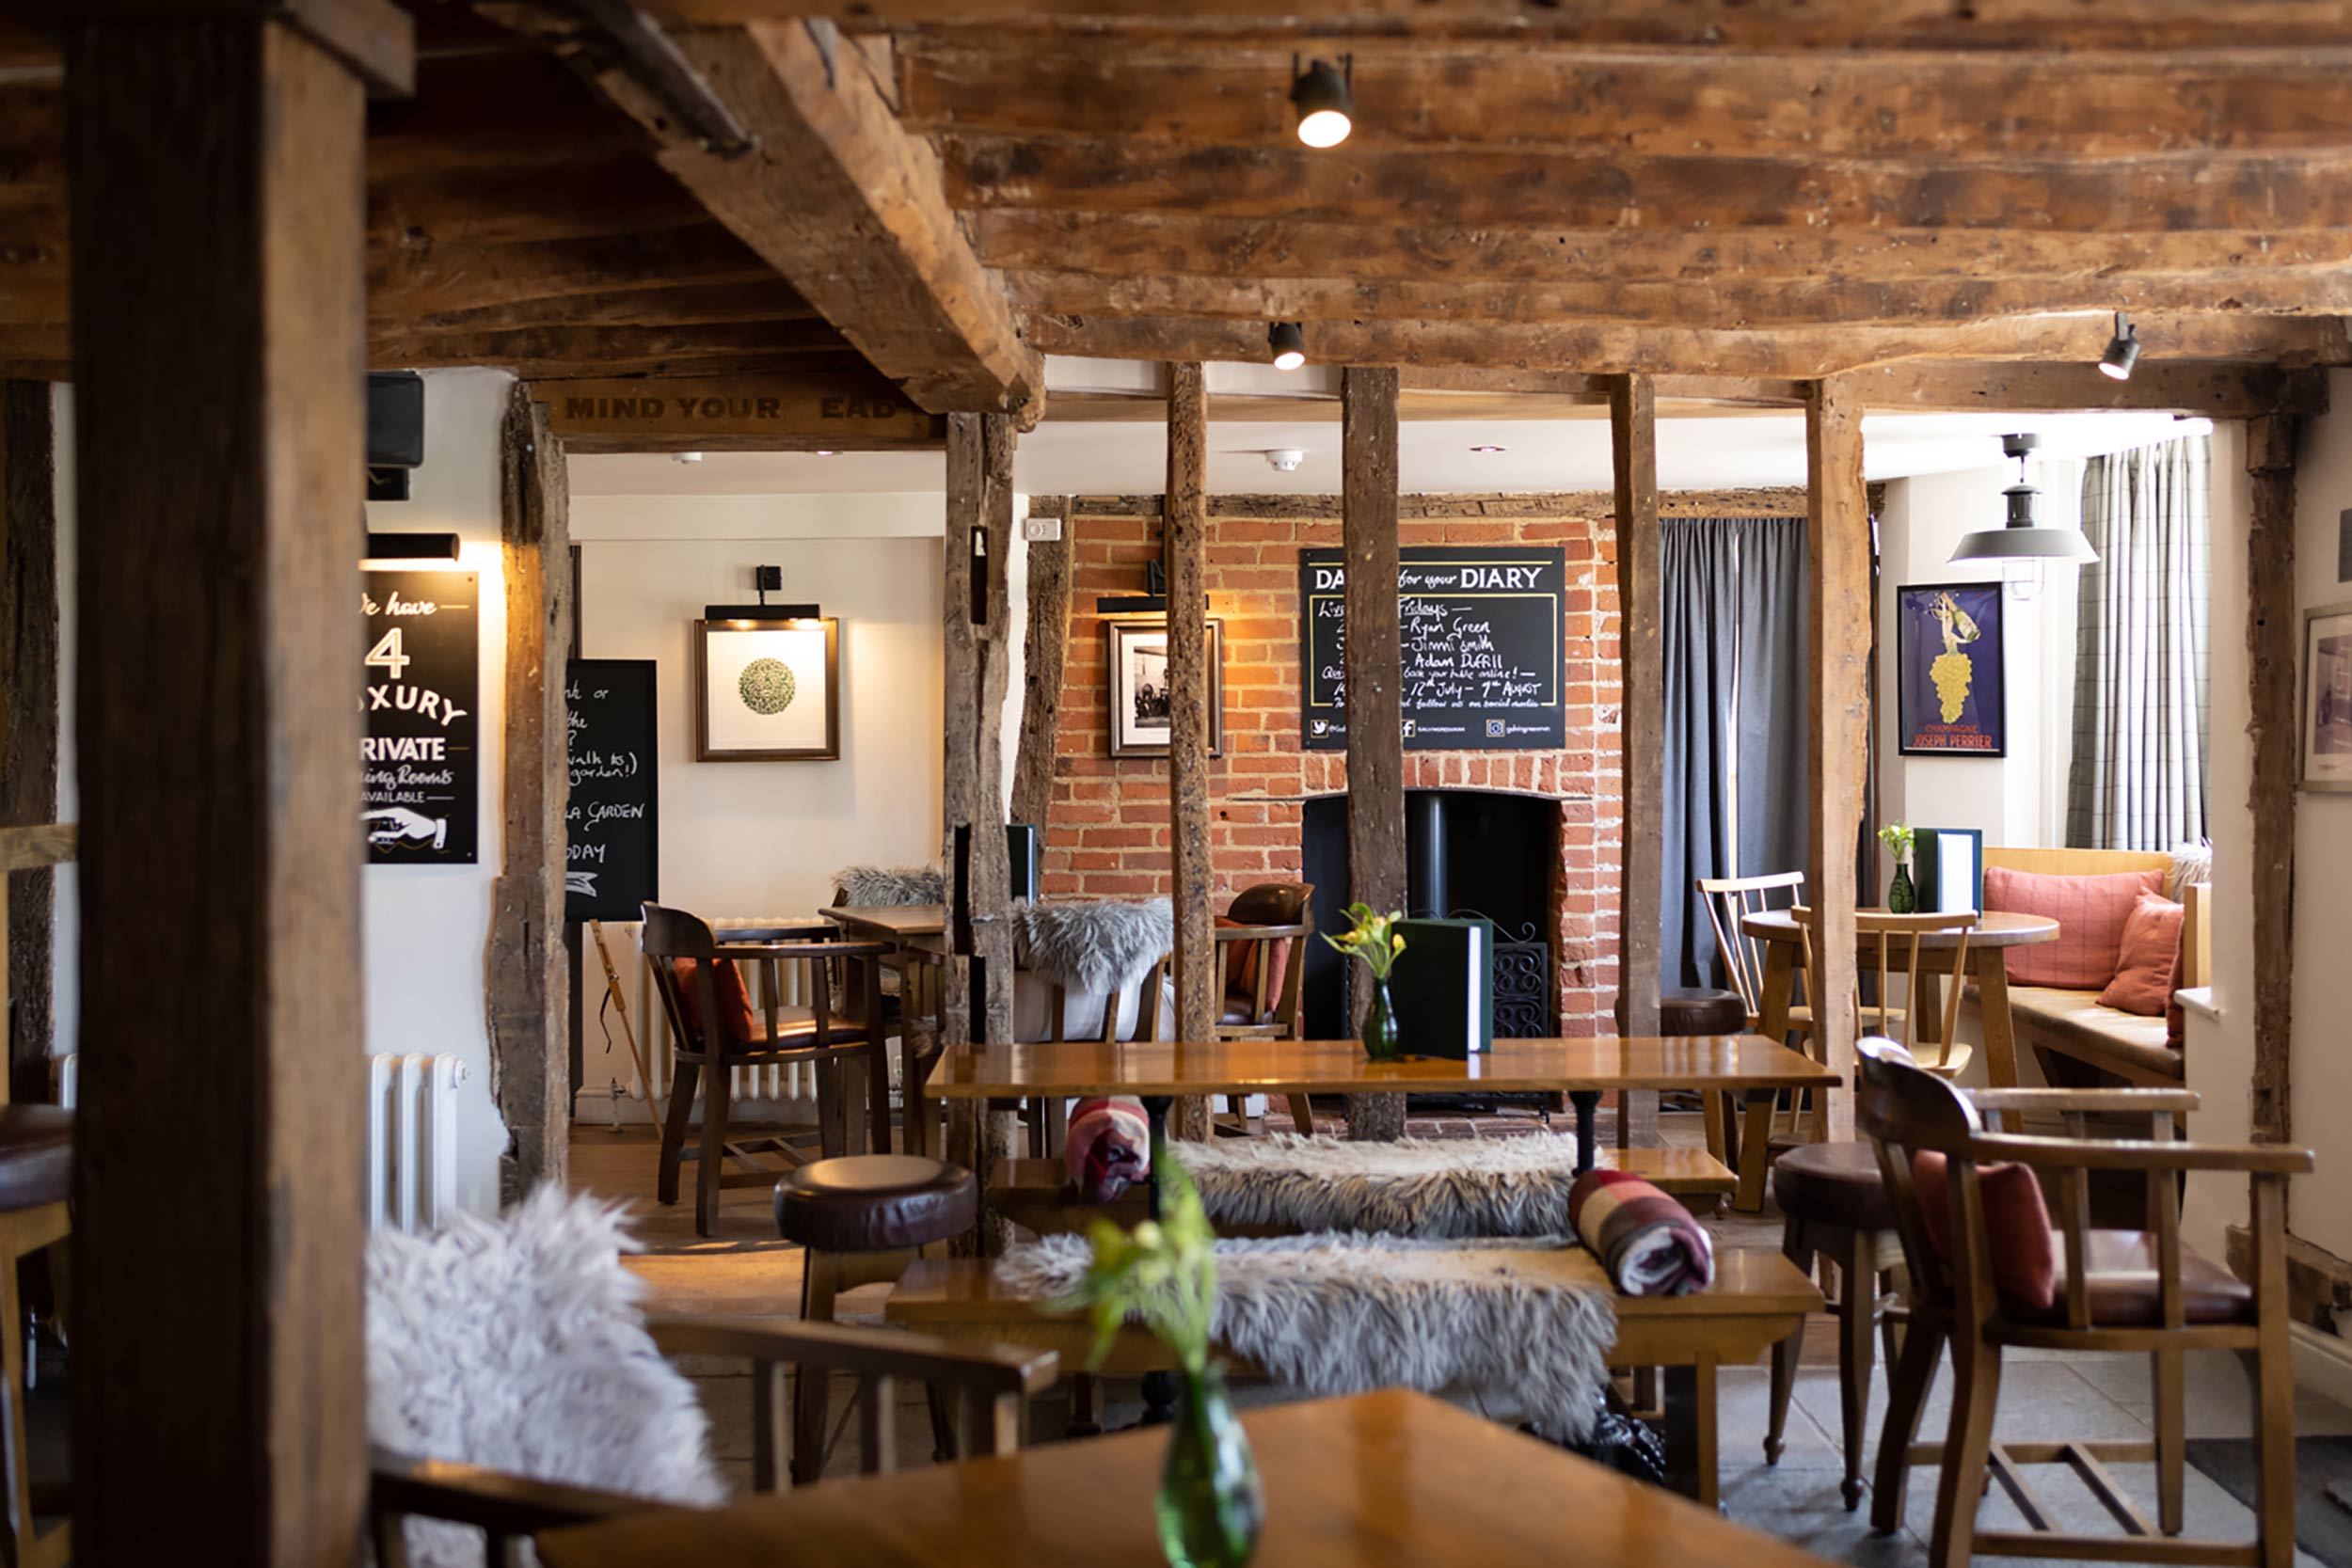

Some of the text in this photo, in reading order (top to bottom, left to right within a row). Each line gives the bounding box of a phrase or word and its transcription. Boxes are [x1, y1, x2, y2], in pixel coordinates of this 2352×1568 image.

[566, 397, 896, 420] MIND YOUR EAD
[1424, 576, 1457, 590] your
[1460, 567, 1543, 589] DIARY
[385, 591, 437, 616] have
[1410, 616, 1491, 641] Ryan Green
[365, 627, 410, 679] 4
[1415, 653, 1454, 668] Adam
[1436, 682, 1463, 700] July
[366, 685, 468, 725] XURY
[359, 737, 446, 761] RIVATE
[1913, 734, 1993, 749] JOSEPH PERRIER
[397, 764, 454, 784] Rooms
[361, 791, 425, 803] AVAILABLE
[584, 800, 645, 832] GARDEN
[565, 844, 606, 863] ODAY
